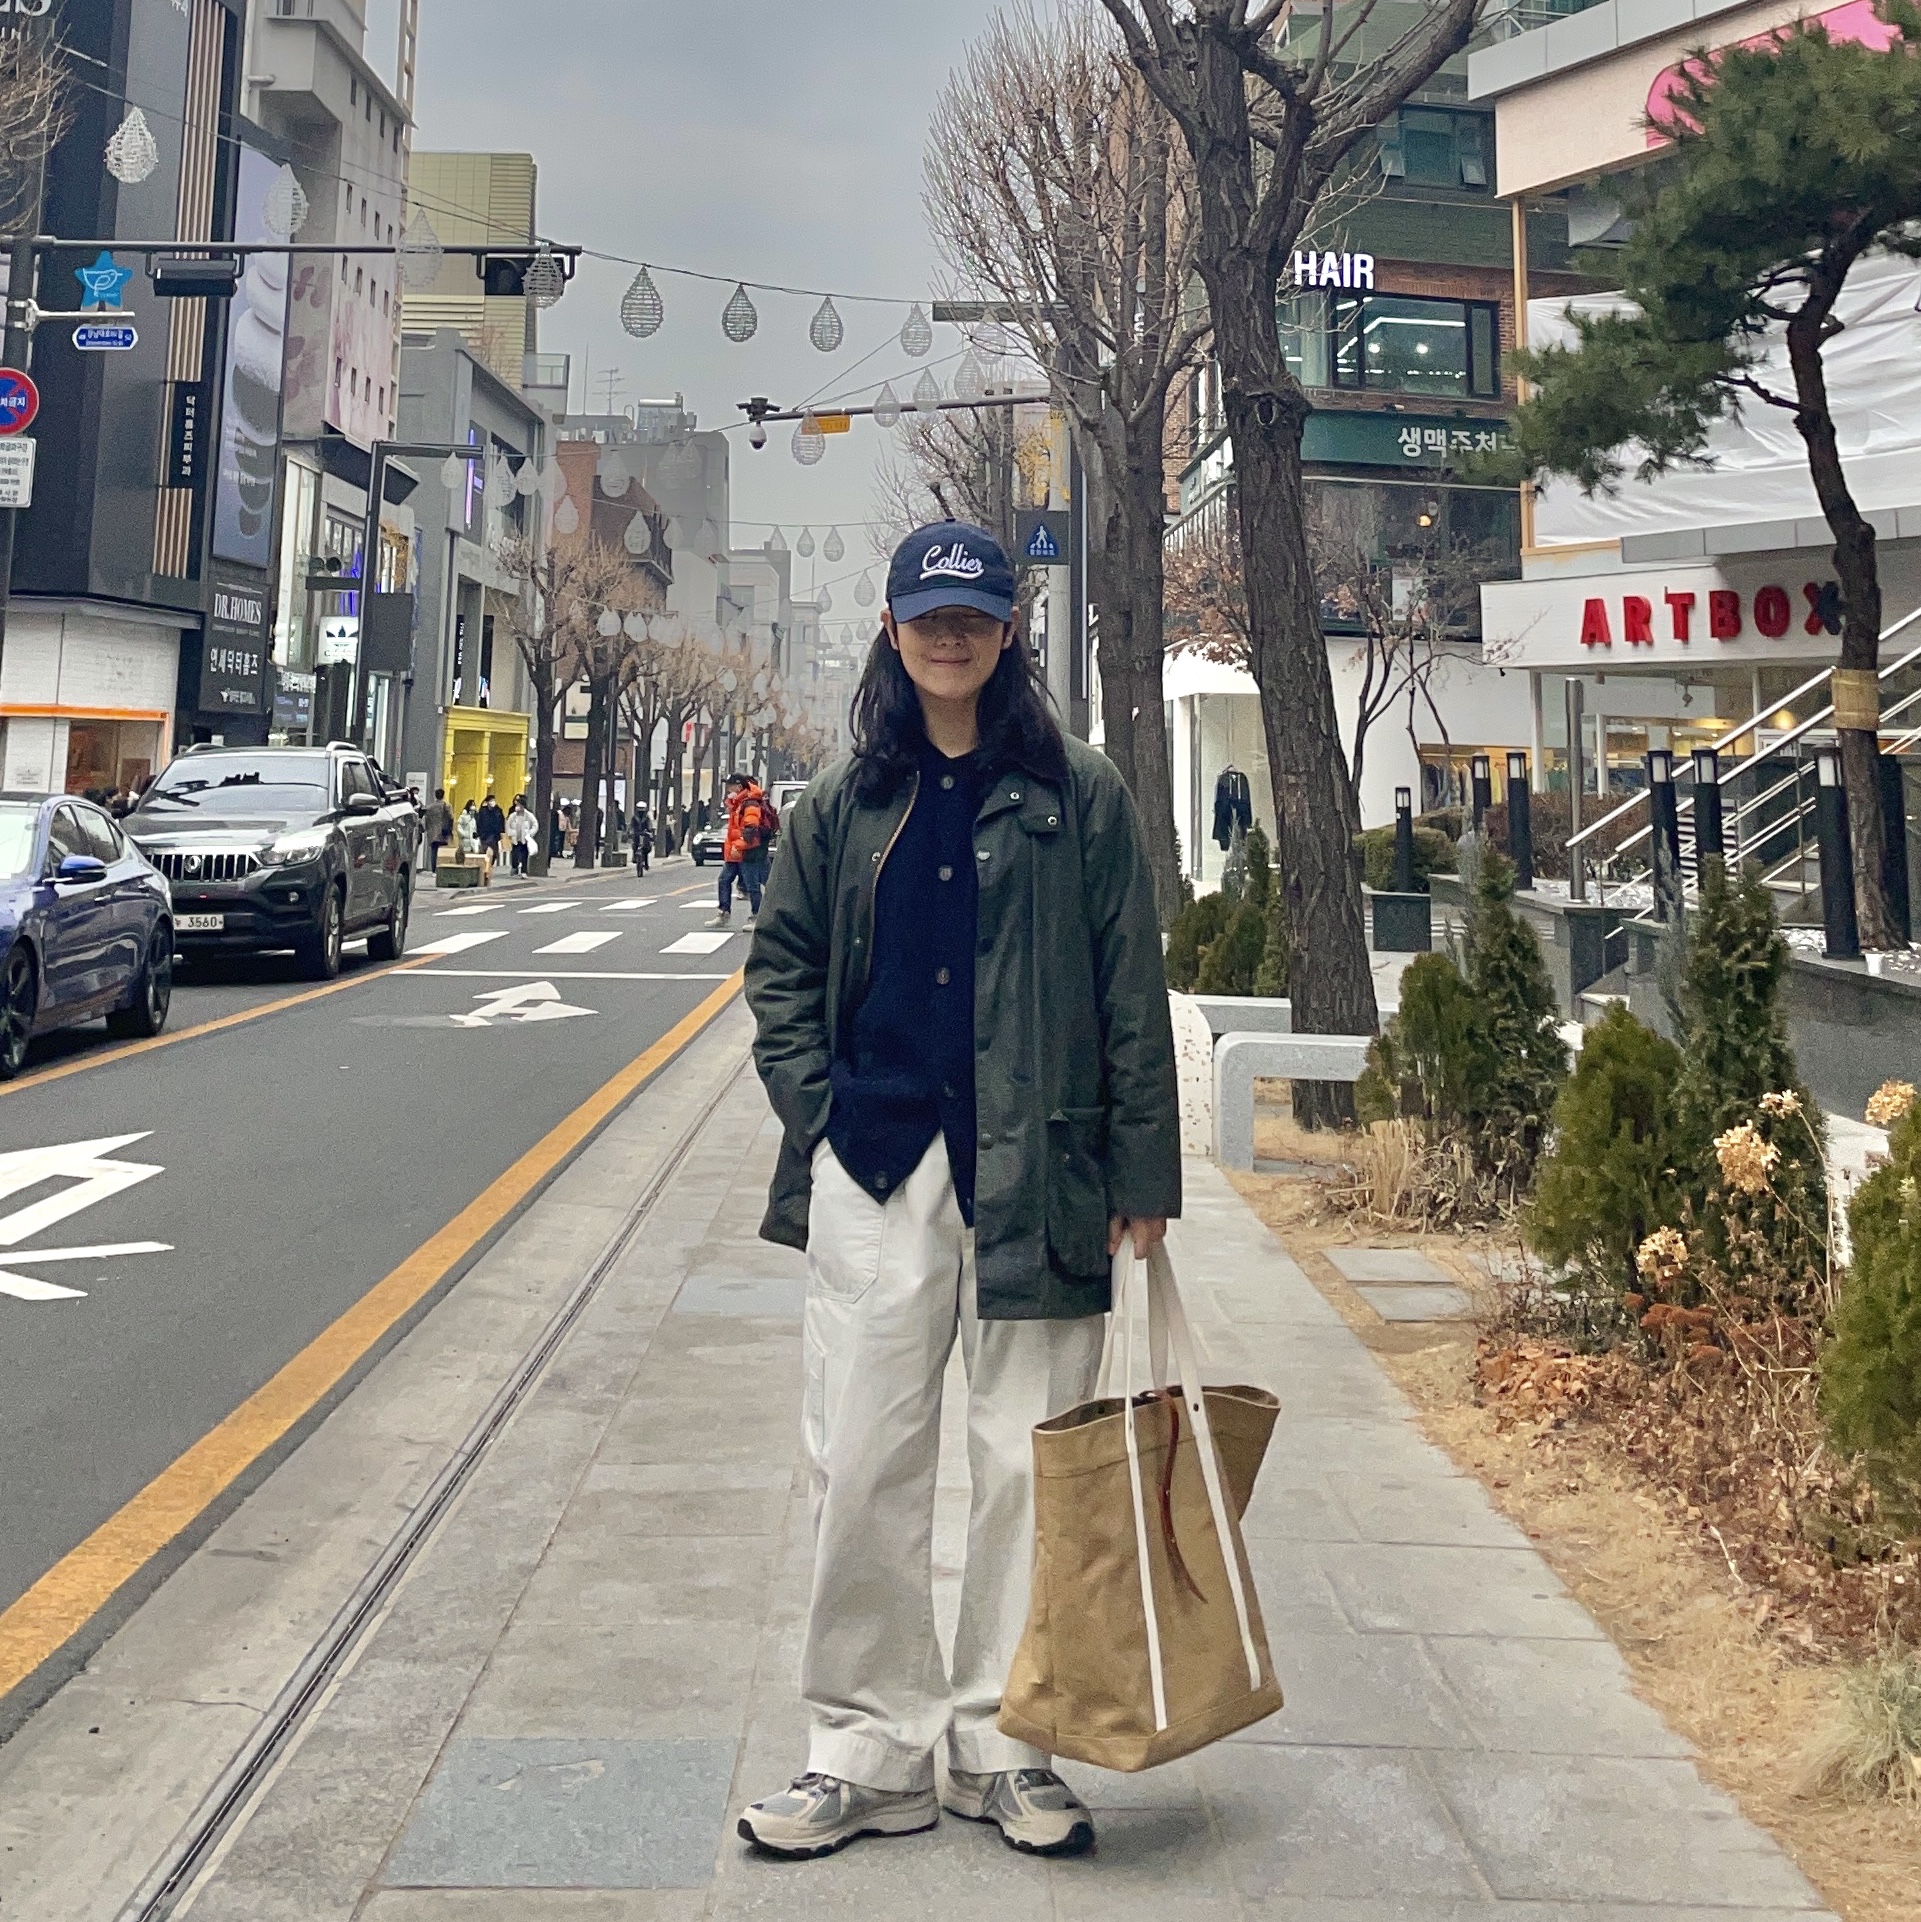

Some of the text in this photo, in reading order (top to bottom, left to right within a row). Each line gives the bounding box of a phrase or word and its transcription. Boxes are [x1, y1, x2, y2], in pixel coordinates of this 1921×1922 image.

[1294, 250, 1374, 289] HAIR
[921, 543, 984, 573] Collier
[1579, 581, 1844, 648] ARTBOX
